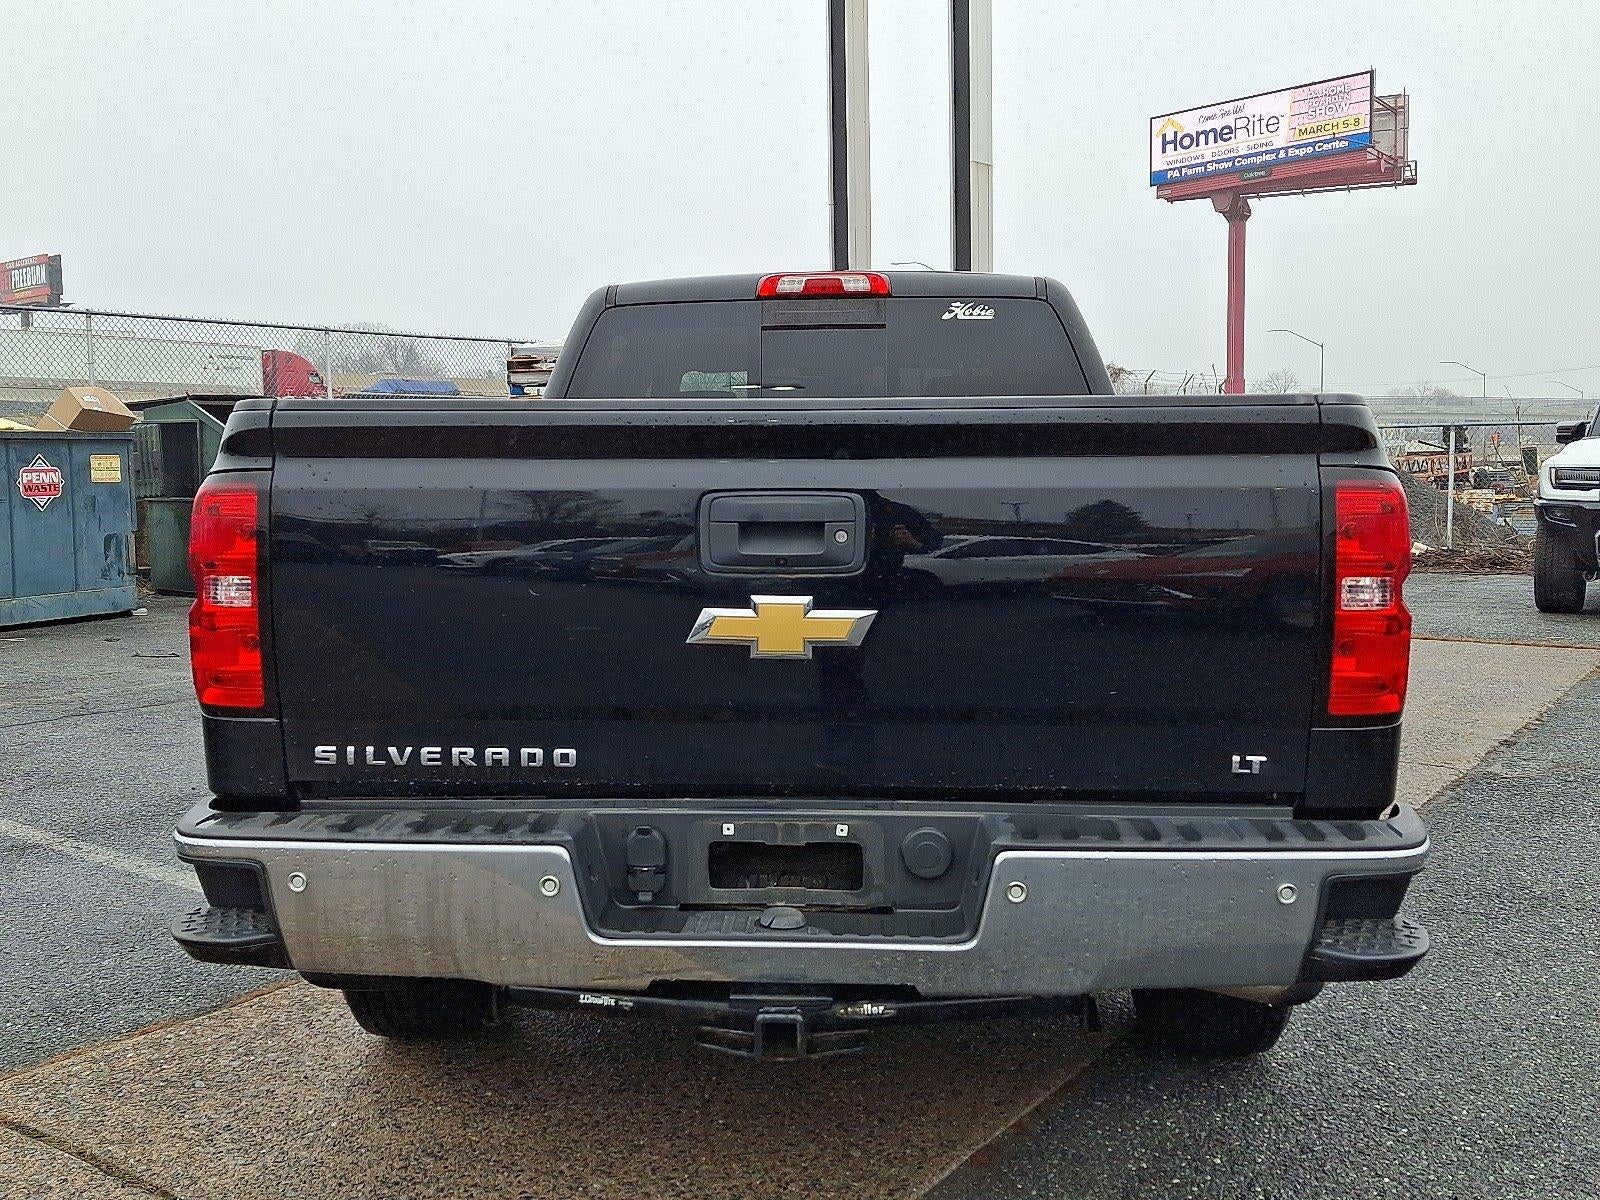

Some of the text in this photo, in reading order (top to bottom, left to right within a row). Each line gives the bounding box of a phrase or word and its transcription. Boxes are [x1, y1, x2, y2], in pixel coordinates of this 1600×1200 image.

[1313, 93, 1351, 107] GARDEN
[1323, 83, 1351, 97] HOME
[1308, 102, 1350, 120] SHOW
[1161, 114, 1280, 154] HomeRite
[1298, 117, 1360, 137] MARCH 5-8
[1166, 140, 1274, 166] WINDOWS DOORS SIDING
[1167, 139, 1349, 179] PA Farm Show Complex & Expo Center
[11, 264, 46, 290] FREEBURN
[941, 301, 996, 320] Hobie
[22, 471, 59, 484] PENN
[23, 483, 60, 493] WASTE
[314, 745, 577, 768] SILVERADO
[1231, 754, 1268, 774] LT
